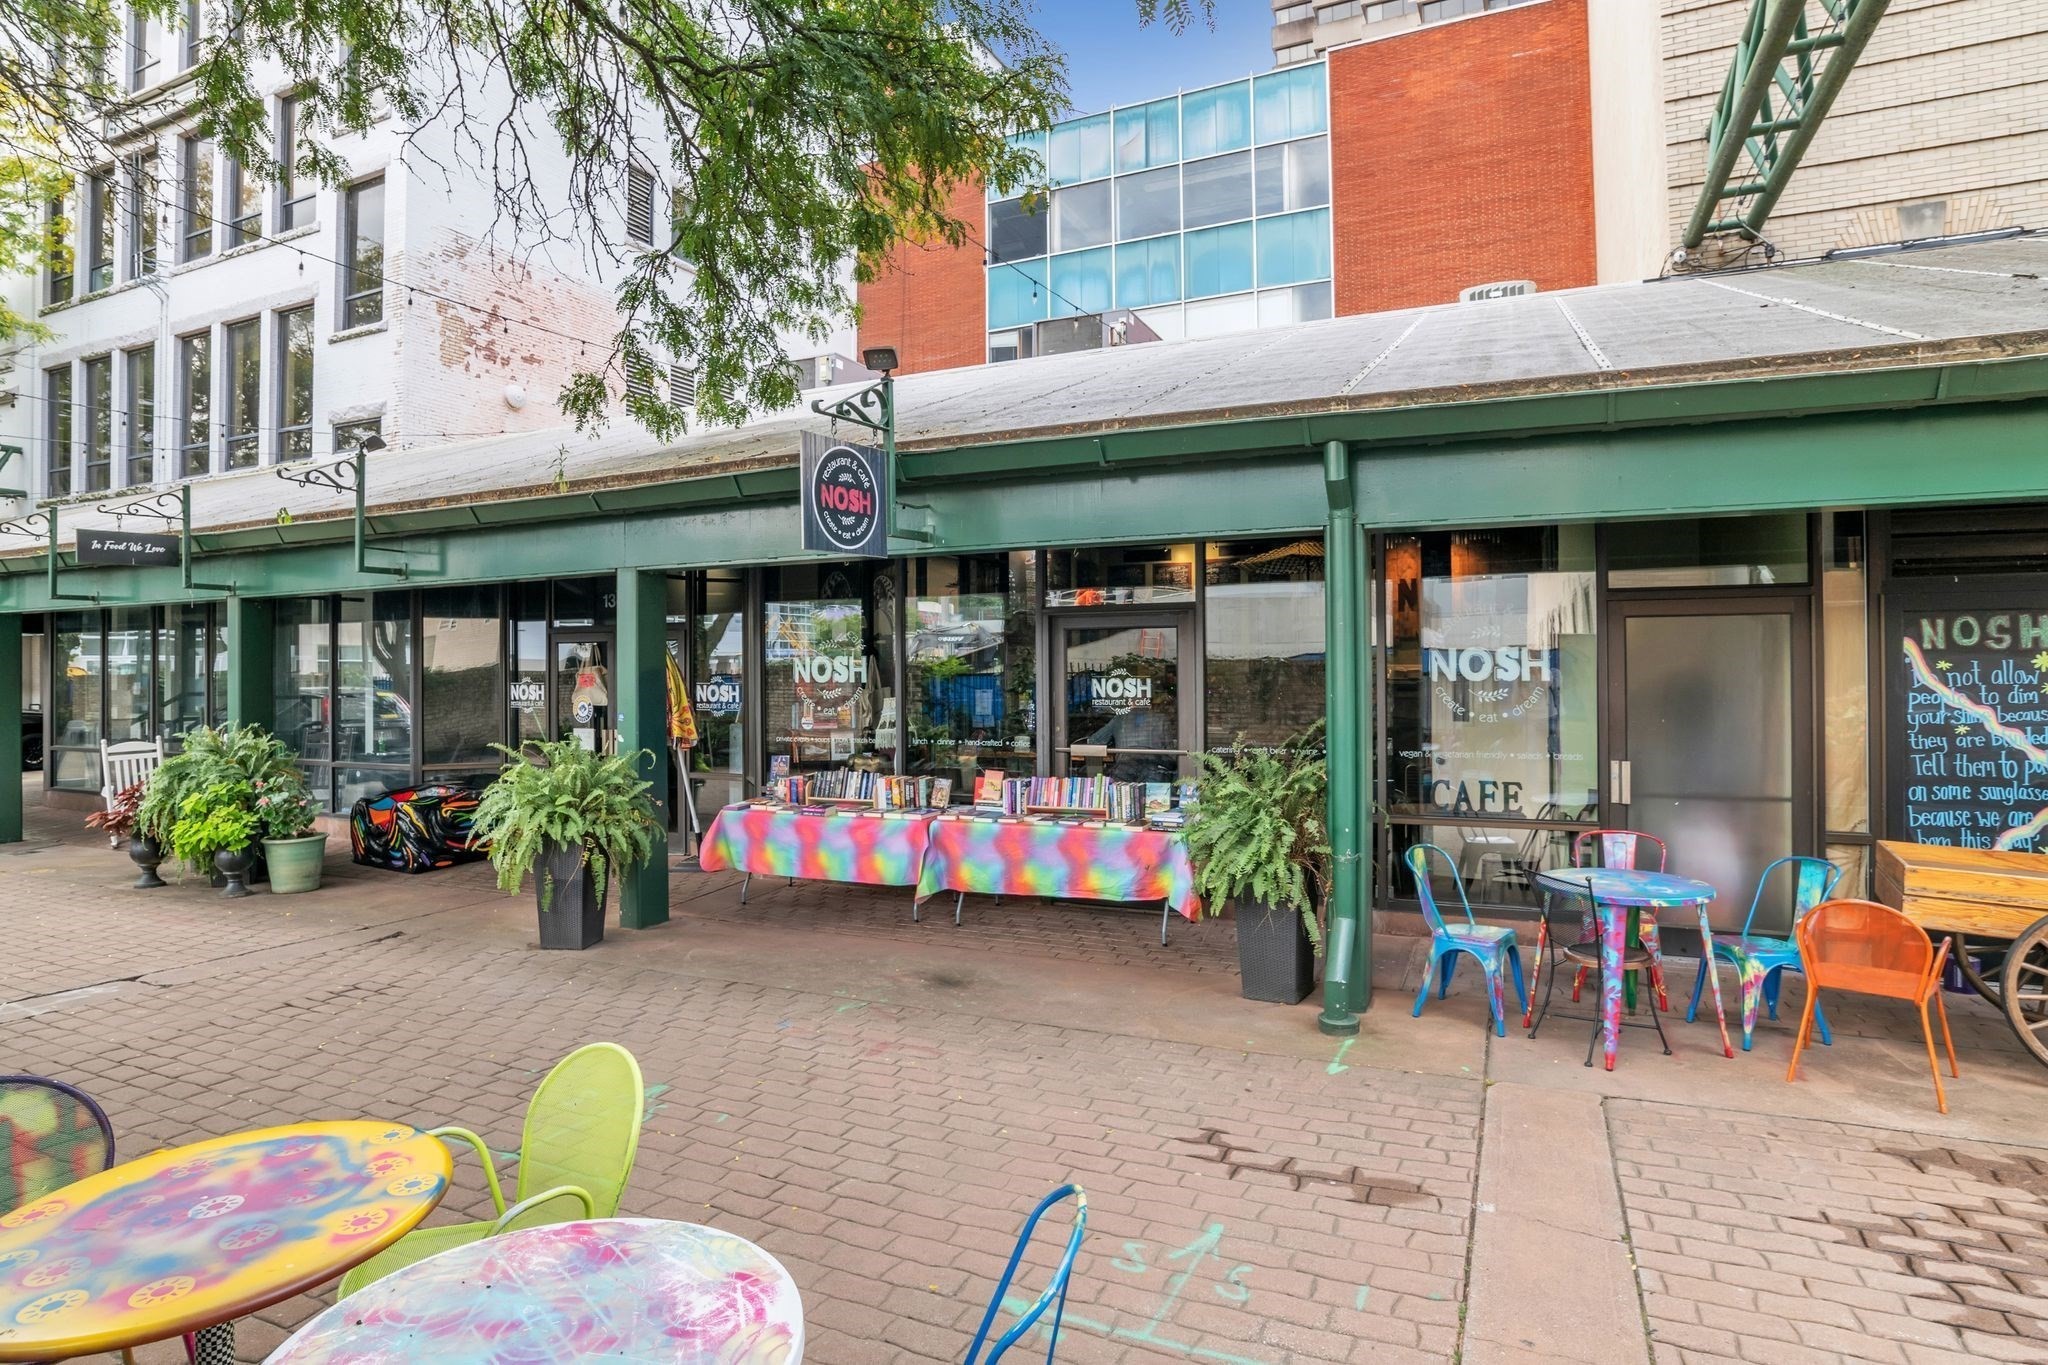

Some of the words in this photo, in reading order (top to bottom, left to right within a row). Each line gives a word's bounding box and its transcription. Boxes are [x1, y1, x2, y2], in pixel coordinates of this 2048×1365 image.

[822, 457, 851, 481] restaurant
[851, 460, 858, 471] &
[821, 483, 871, 515] NOSH
[823, 511, 838, 533] create
[855, 517, 869, 536] dream
[91, 539, 102, 549] In
[104, 540, 127, 551] Food
[128, 542, 143, 552] We
[145, 543, 166, 553] Love
[1920, 614, 2048, 649] NOSH
[794, 655, 867, 683] NOSH
[1429, 646, 1550, 682] NOSH
[1946, 660, 1980, 687] not
[1991, 659, 2040, 685] allow
[510, 684, 545, 701] NOSH
[696, 684, 740, 702] NOSH
[1091, 677, 1152, 698] NOSH
[1979, 684, 2000, 705] to
[2008, 684, 2038, 704] dim
[797, 687, 815, 709] create
[823, 707, 836, 715] eat
[844, 686, 864, 709] dream
[1436, 687, 1465, 716] create
[1479, 713, 1498, 723] eat
[1512, 686, 1545, 717] dream
[1907, 711, 1950, 733] your
[937, 738, 956, 746] dinner
[964, 738, 1003, 747] hand-crafted
[1010, 740, 1031, 748] coffee
[1399, 750, 1423, 759] vegan
[1424, 750, 1431, 758] &
[1908, 733, 1948, 754] they
[1956, 735, 1986, 748] are
[1910, 752, 1947, 776] Tell
[1953, 753, 1997, 777] them
[1998, 751, 2018, 779] to
[1432, 779, 1523, 815] CAFE
[1908, 785, 1927, 802] on
[1931, 785, 1971, 800] some
[1907, 805, 1972, 828] because
[1974, 811, 2000, 827] we
[2008, 811, 2034, 827] are
[1960, 827, 1991, 849] this
